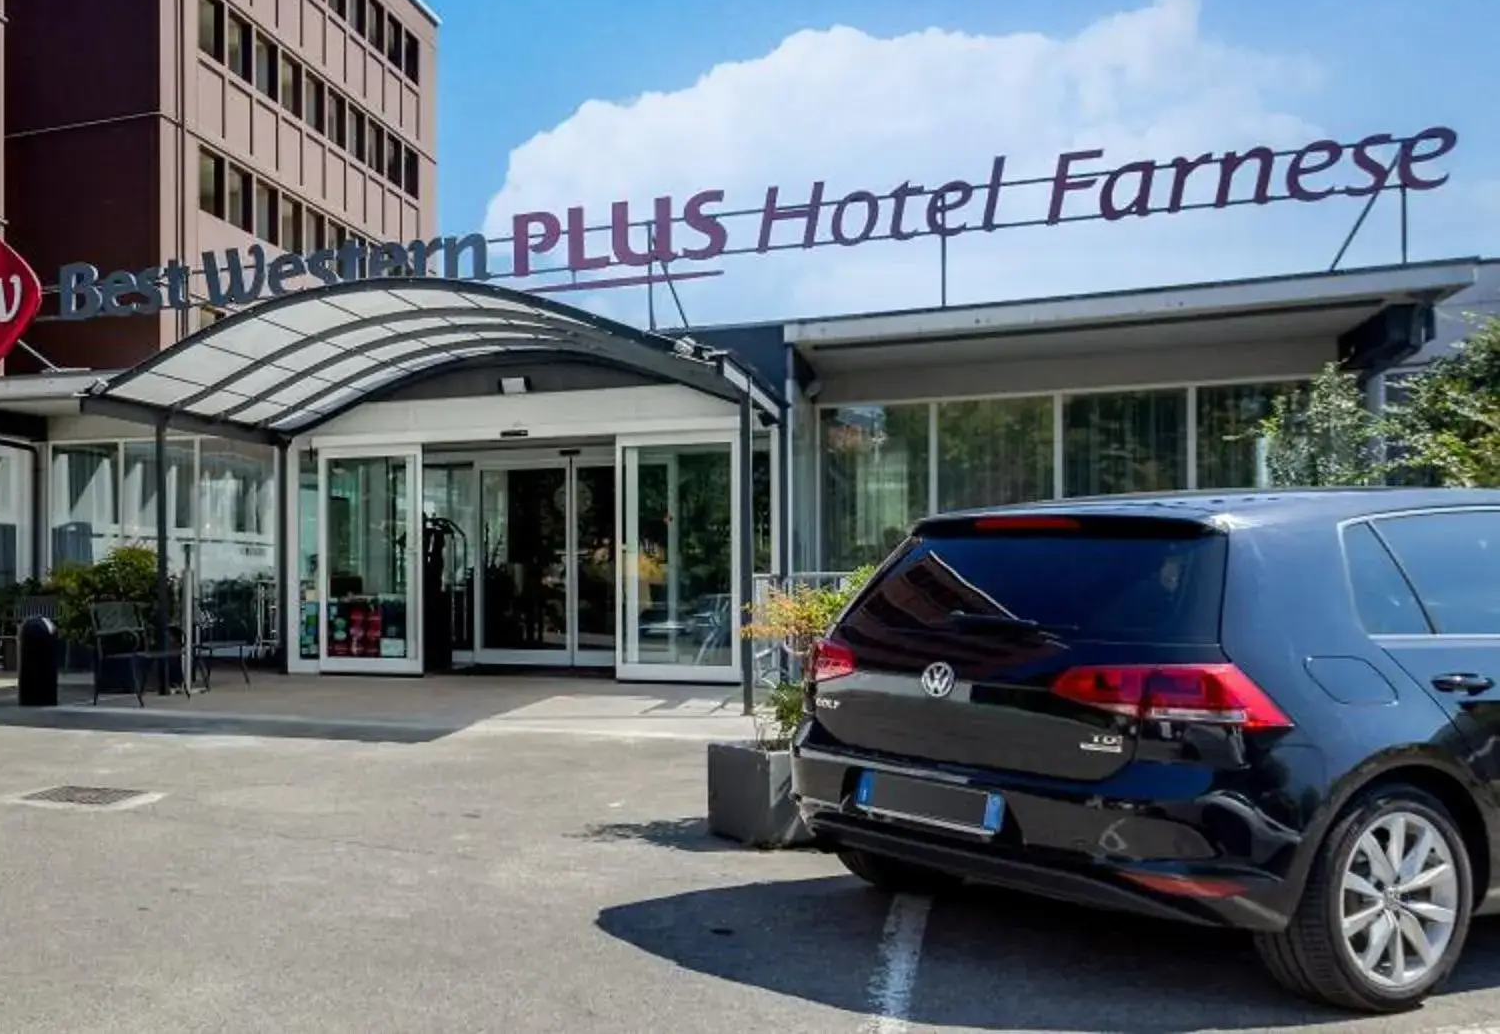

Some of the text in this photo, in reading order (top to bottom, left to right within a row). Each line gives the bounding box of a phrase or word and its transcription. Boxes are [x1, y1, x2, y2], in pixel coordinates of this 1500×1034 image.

[59, 126, 1458, 320] Best Western PLUS Hotel Farnese
